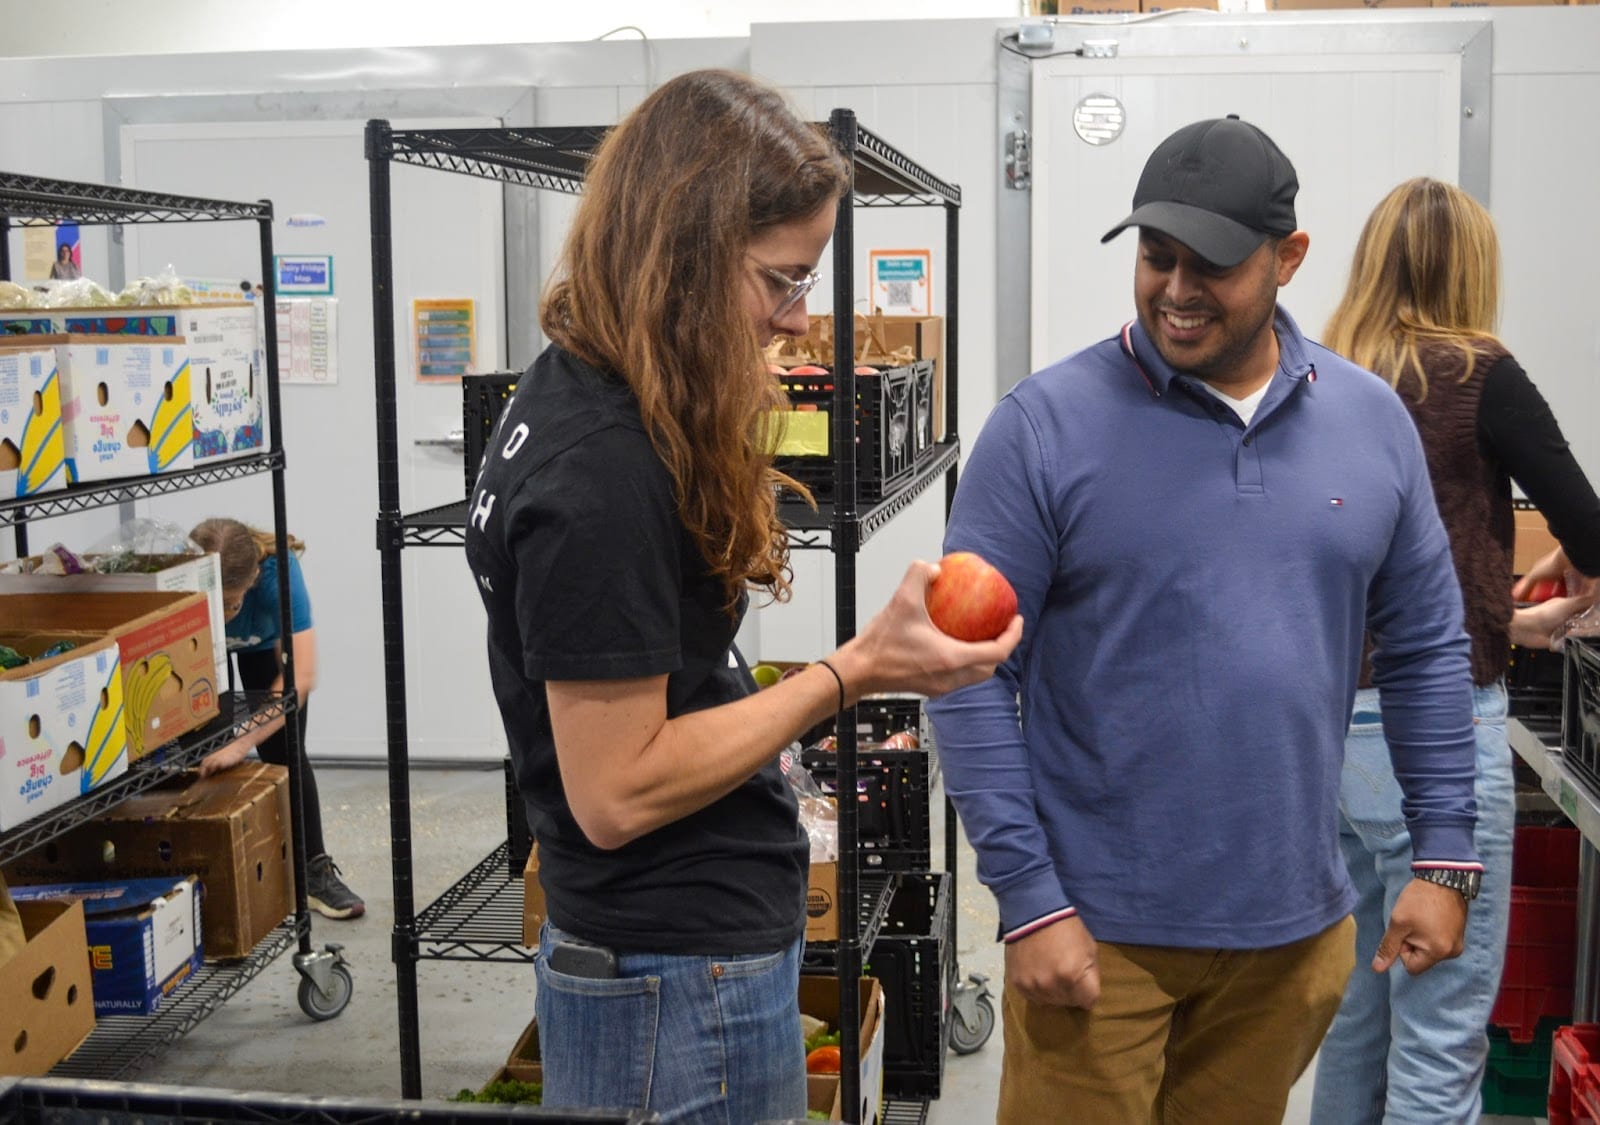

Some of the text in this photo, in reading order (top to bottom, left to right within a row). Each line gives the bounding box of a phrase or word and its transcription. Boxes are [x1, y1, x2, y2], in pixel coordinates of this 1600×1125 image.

[100, 425, 115, 439] big
[93, 440, 122, 453] change
[16, 749, 52, 768] difference
[29, 765, 45, 778] big
[19, 775, 53, 795] change
[95, 1000, 143, 1009] NATURALLY
